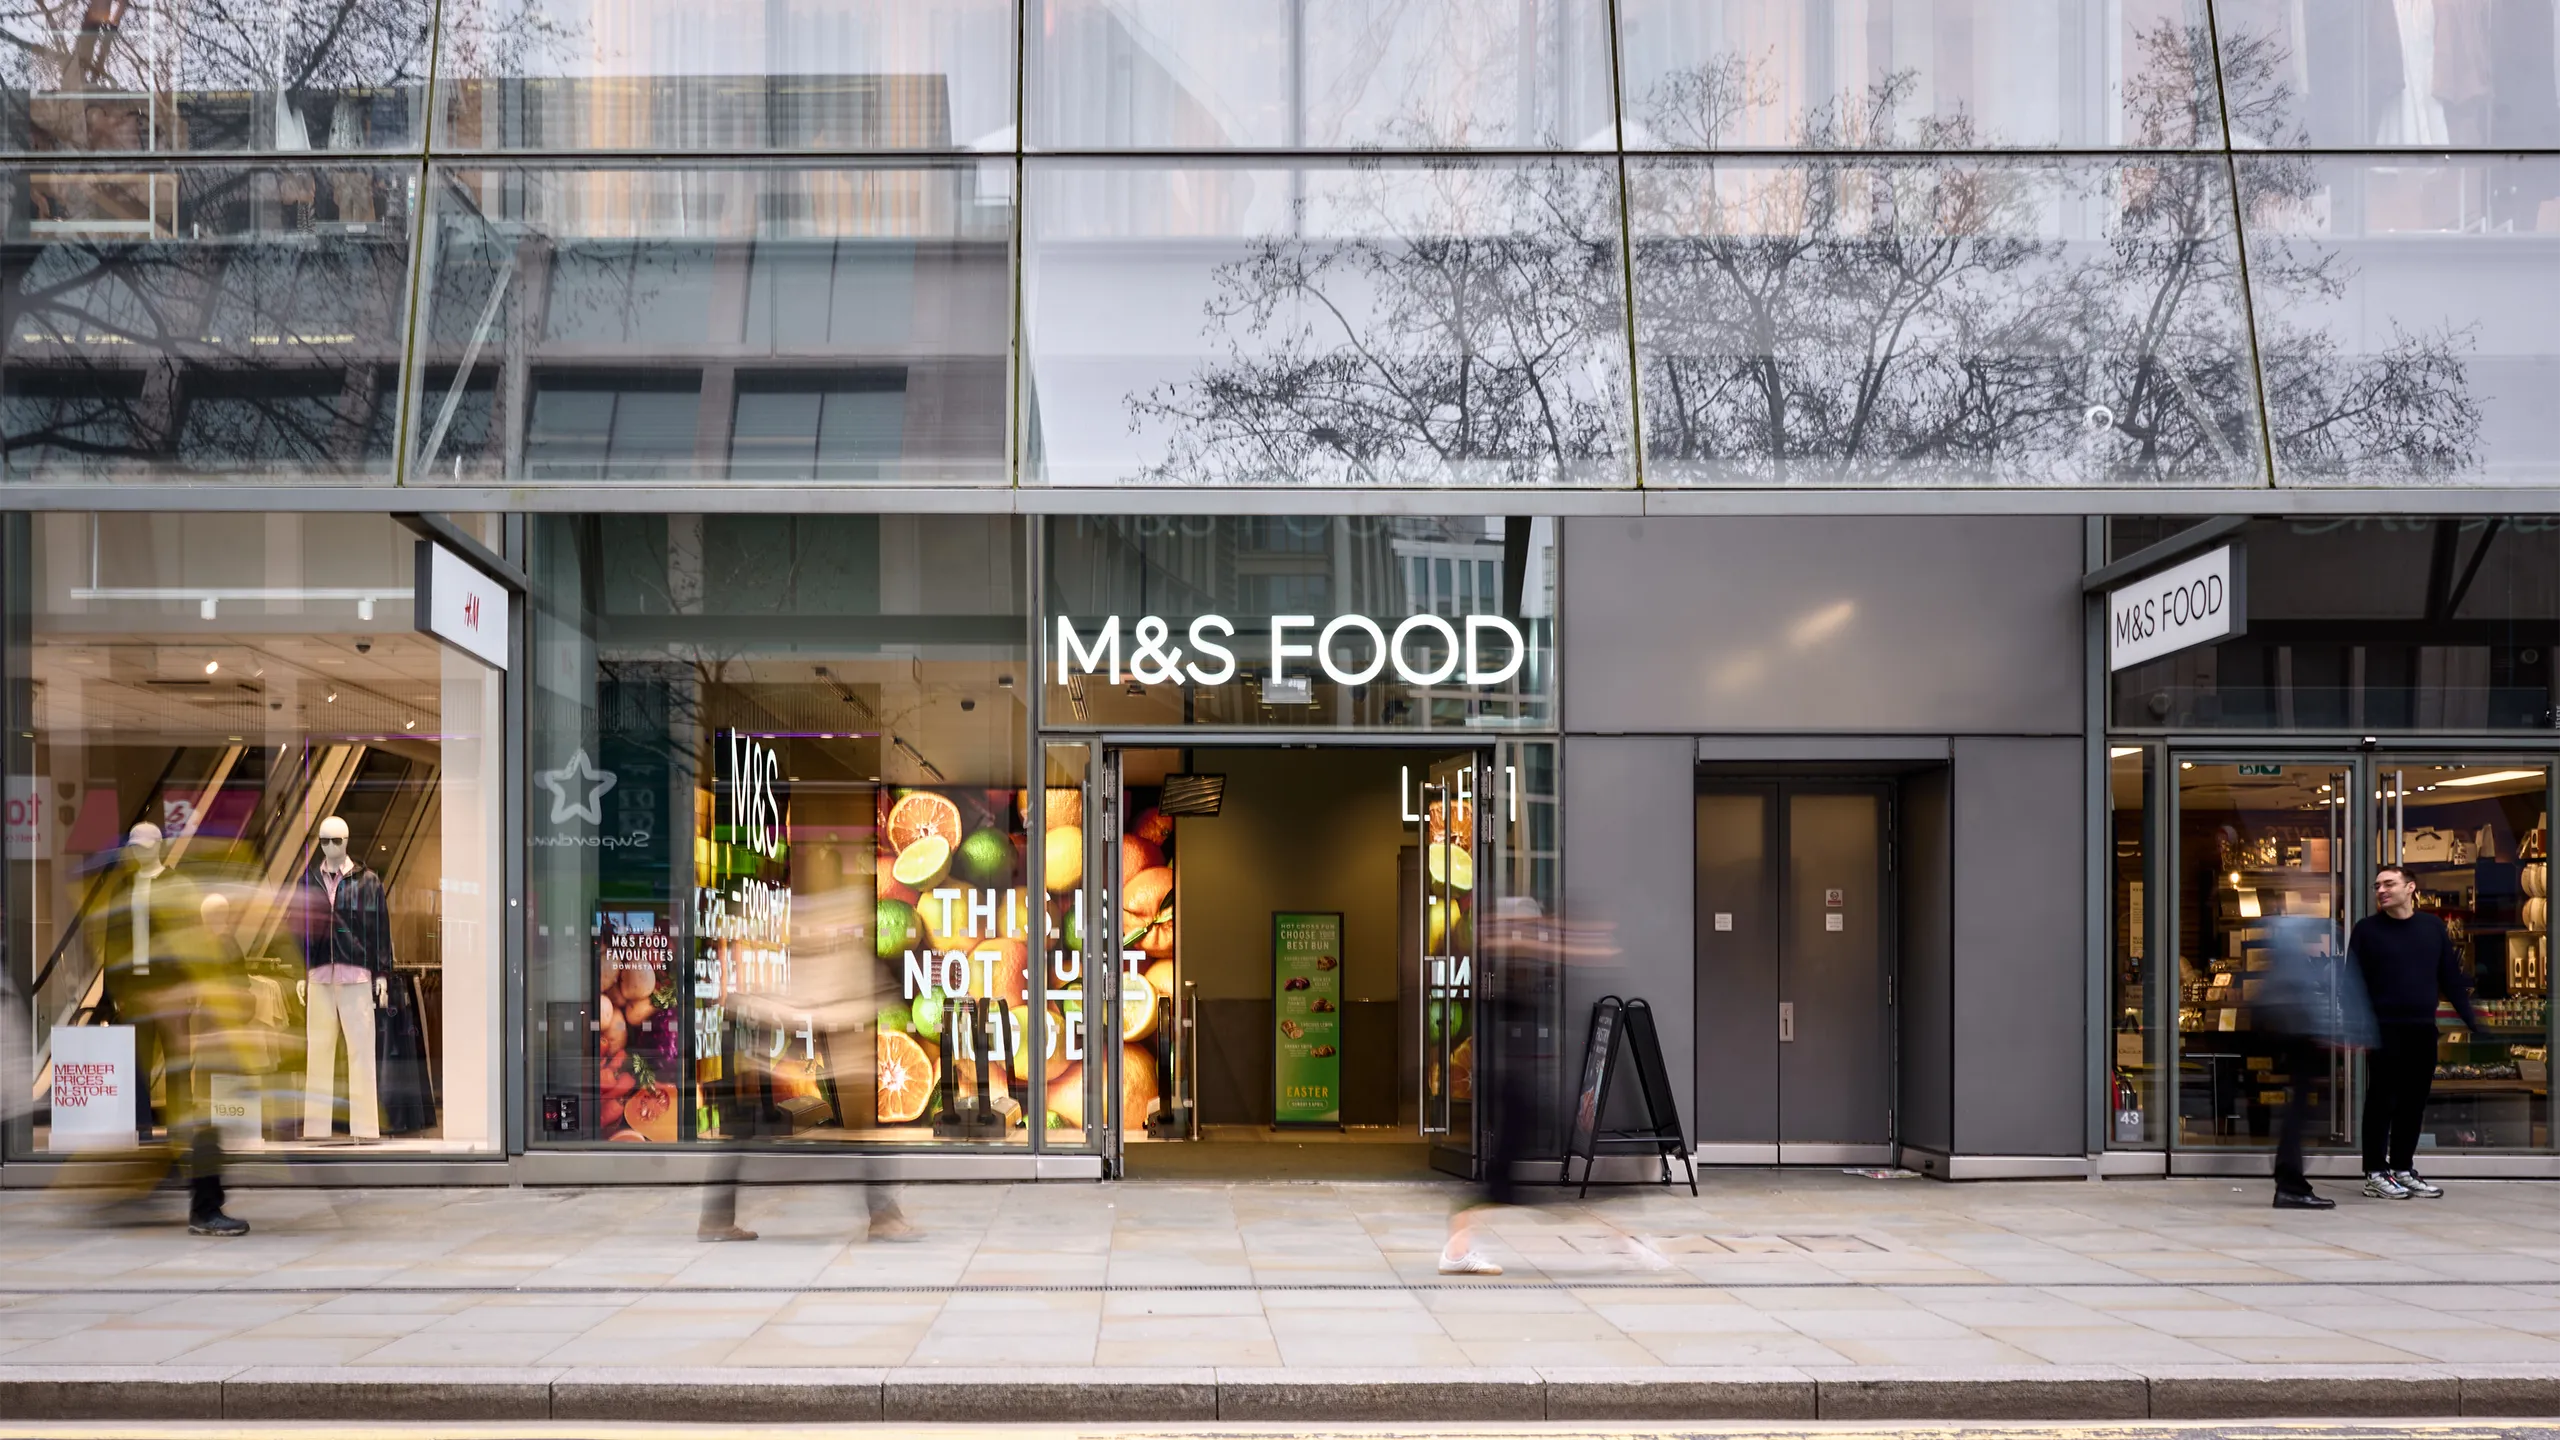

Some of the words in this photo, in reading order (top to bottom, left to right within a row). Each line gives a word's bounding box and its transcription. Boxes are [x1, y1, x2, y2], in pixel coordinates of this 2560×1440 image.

[2116, 598, 2155, 649] M&S
[2162, 574, 2223, 632] FOOD
[1057, 614, 1235, 687] M&S
[1270, 614, 1525, 687] FOOD
[731, 726, 779, 859] M&S
[1280, 930, 1317, 940] CHOOSE
[611, 935, 635, 948] M&S
[639, 935, 668, 948] FOOD
[1286, 940, 1309, 950] BEST
[1311, 940, 1330, 950] BUN
[606, 948, 674, 962] FAVOURITES
[612, 962, 667, 971] DOWNSTAIRS
[903, 950, 1002, 1000] NOT
[54, 1064, 115, 1075] MEMBER
[54, 1075, 104, 1086] PRICES
[54, 1085, 118, 1097] IN-STORE
[1286, 1086, 1329, 1098] EASTER
[54, 1096, 88, 1107] NOW
[2120, 1111, 2140, 1125] 43
